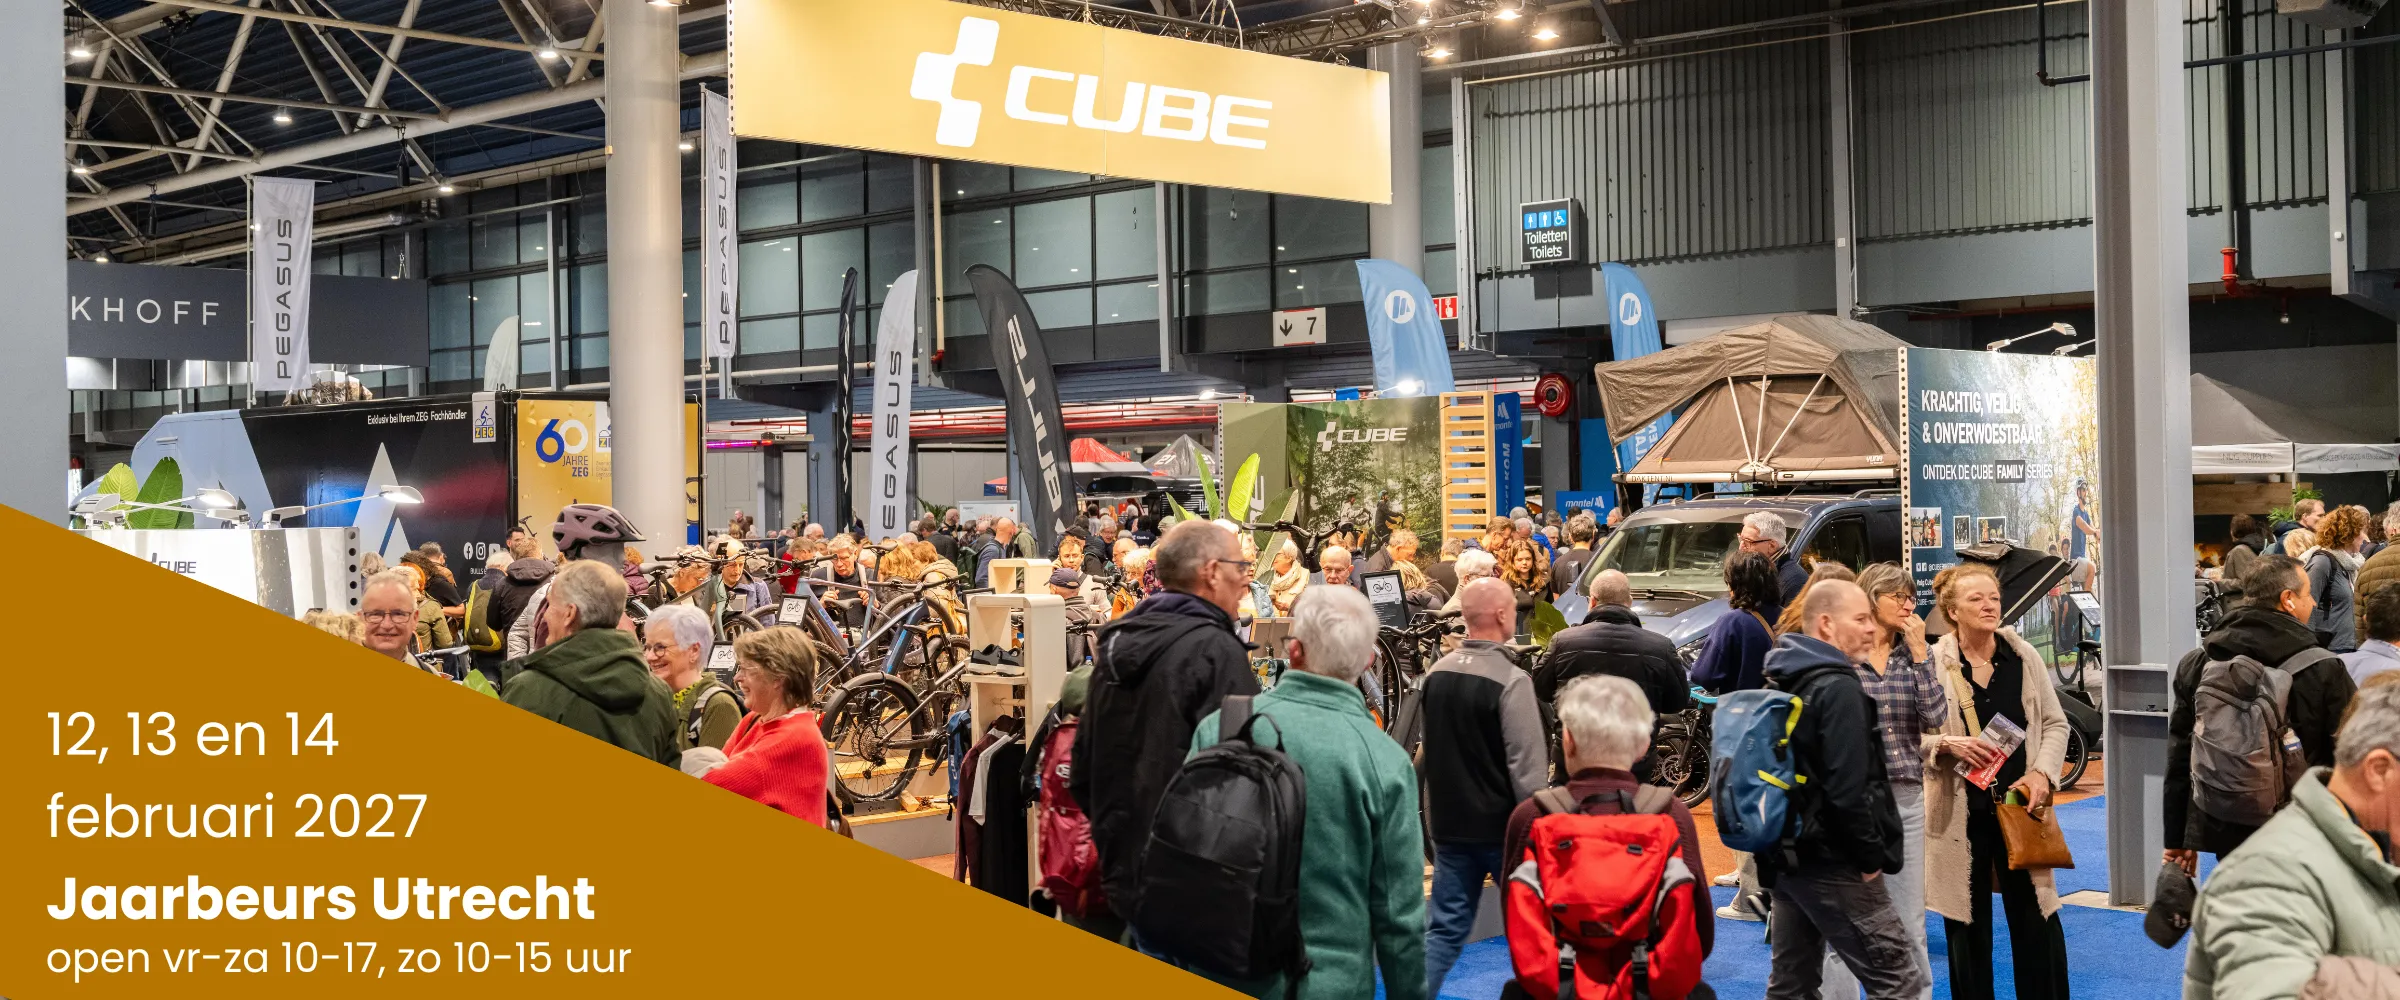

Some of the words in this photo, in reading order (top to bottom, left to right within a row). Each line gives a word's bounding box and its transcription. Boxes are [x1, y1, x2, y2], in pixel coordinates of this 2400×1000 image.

[1005, 65, 1273, 149] CUBE
[719, 147, 730, 344] PEGASUS
[1524, 230, 1567, 245] Toiletten
[1530, 245, 1562, 259] Toilets
[277, 218, 293, 380] PEGASUS
[71, 296, 220, 326] KHOFF
[1307, 317, 1317, 335] 7
[1921, 390, 1984, 417] KRACHTIG,
[1986, 392, 2021, 414] VEILIG
[368, 414, 389, 425] Exklusiv
[390, 413, 398, 424] bei
[399, 412, 415, 423] Ihrem
[416, 412, 428, 422] ZEG
[431, 409, 467, 421] Fachhändler
[475, 427, 494, 438] ZEG
[536, 419, 588, 463] 60
[1337, 427, 1408, 444] CUBE
[1922, 422, 1931, 443] &
[882, 350, 902, 541] EGASUS
[562, 456, 588, 467] JAHRE
[572, 467, 589, 477] ZEG
[1922, 464, 1957, 480] ONTDEK
[1958, 465, 1970, 480] DE
[1971, 464, 1994, 480] CUBE
[1997, 464, 2024, 480] FAMILY
[2026, 464, 2053, 479] SERIES
